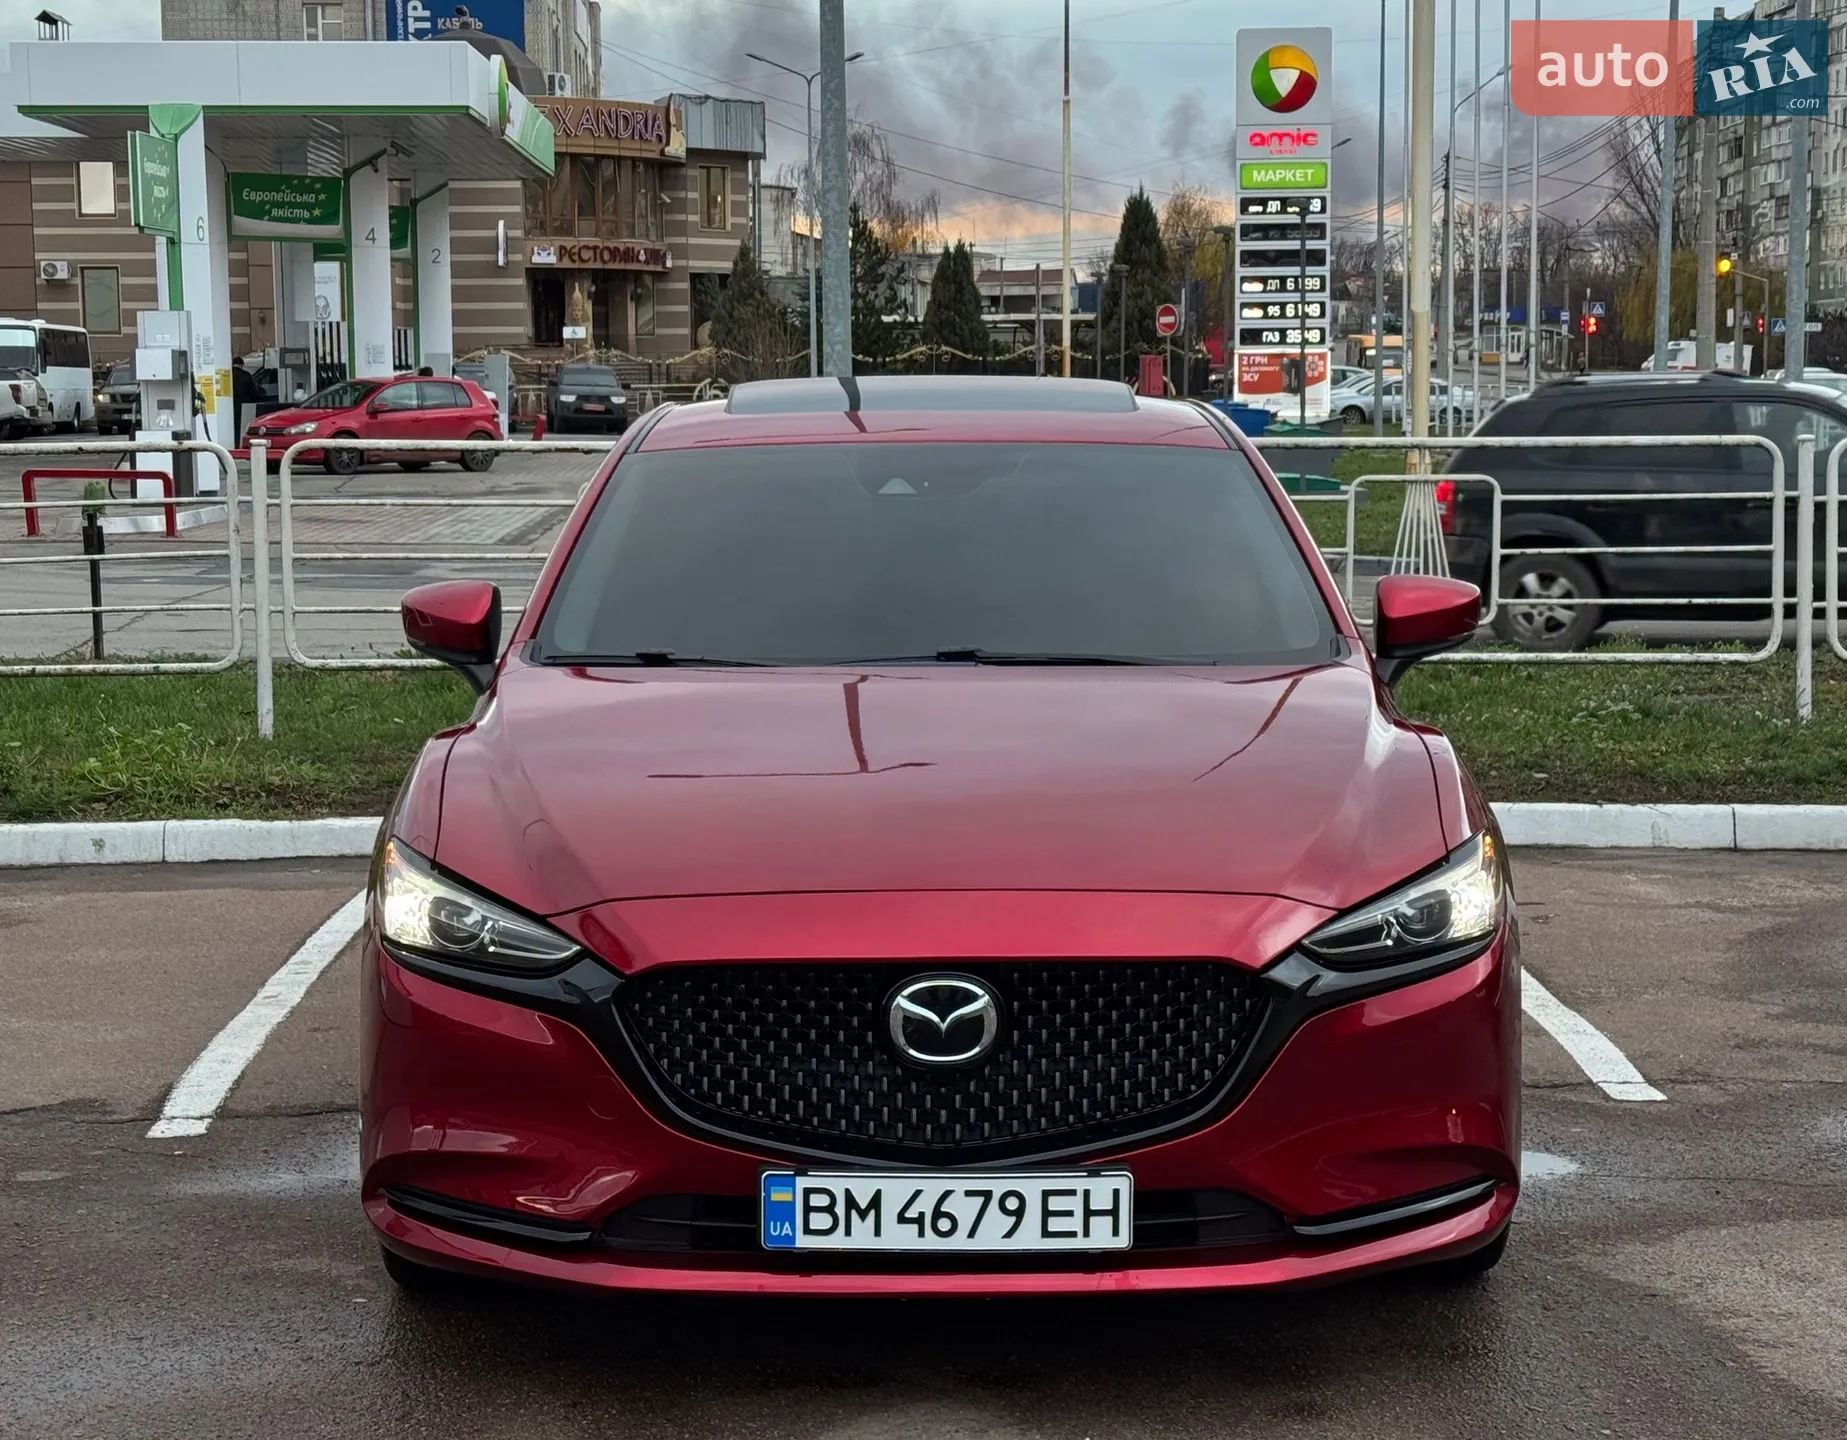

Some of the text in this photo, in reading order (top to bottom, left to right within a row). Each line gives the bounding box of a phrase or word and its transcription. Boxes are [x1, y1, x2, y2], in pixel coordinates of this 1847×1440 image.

[1249, 128, 1318, 146] amic
[1252, 169, 1315, 182] МАРКЕТ
[242, 188, 316, 203] Європейська
[271, 204, 310, 218] якість
[196, 216, 205, 242] 6
[365, 227, 377, 245] 4
[431, 248, 441, 264] 2
[1267, 305, 1281, 317] 95
[1262, 331, 1280, 343] ГАЗ
[1242, 356, 1268, 365] 2 ГРН
[1242, 373, 1259, 382] ЗСУ
[802, 1186, 1121, 1239] BM 4679 EH
[770, 1221, 793, 1237] UA
